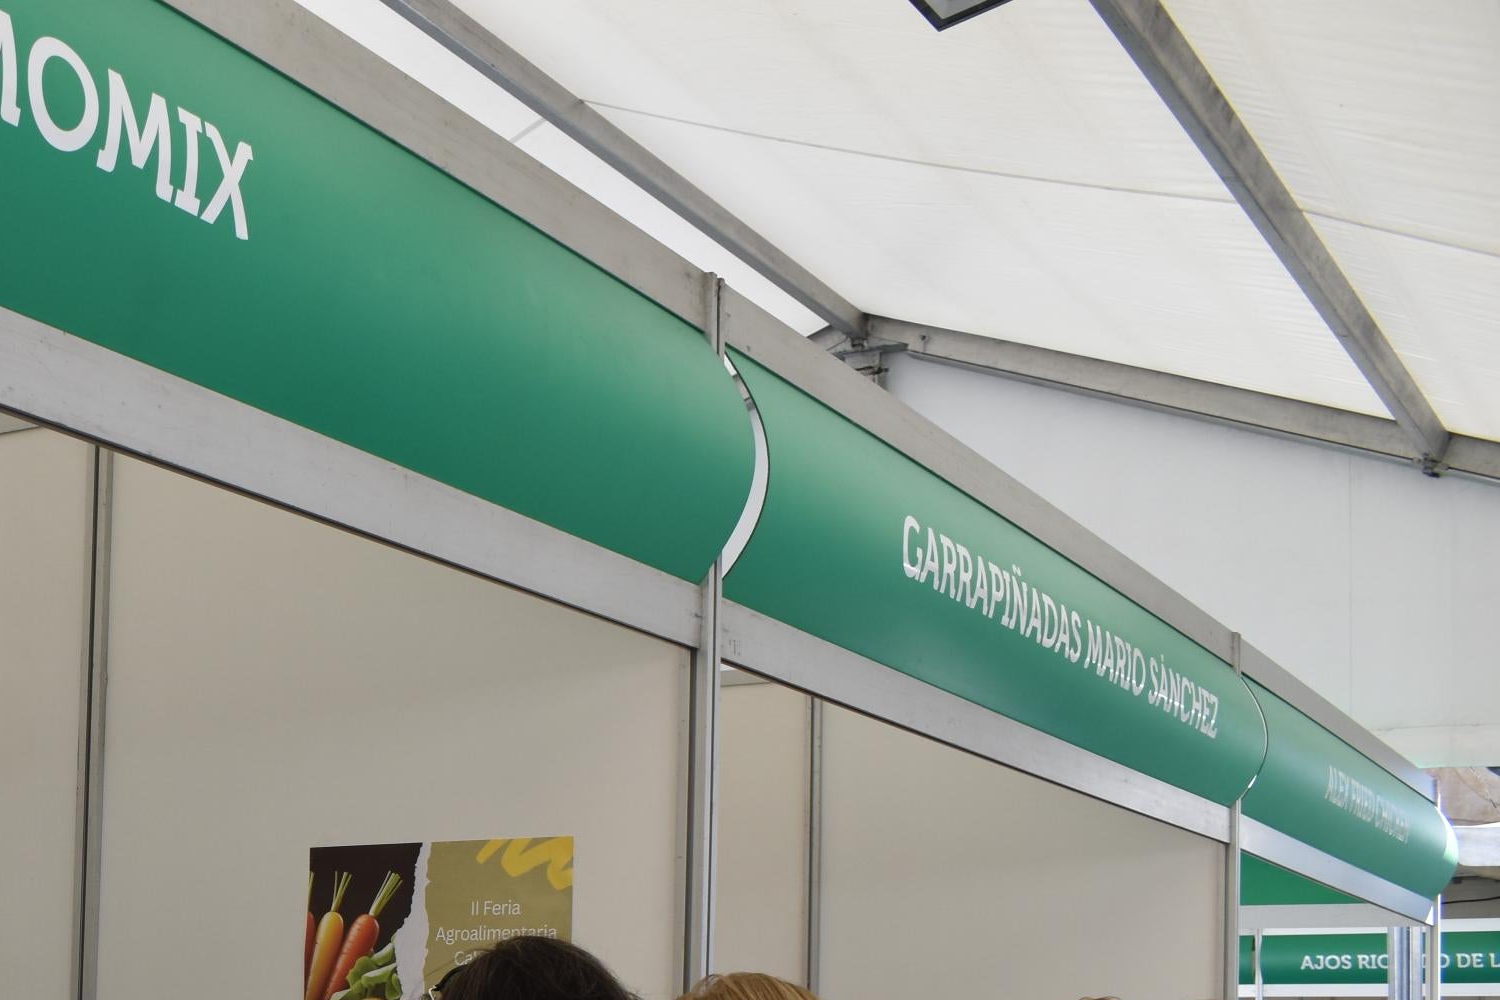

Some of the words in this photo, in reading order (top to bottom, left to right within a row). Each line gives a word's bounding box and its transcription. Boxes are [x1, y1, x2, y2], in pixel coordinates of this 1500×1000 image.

[903, 515, 1082, 663] GARRAPIÑADAS
[1084, 619, 1146, 696] MARIO
[1148, 654, 1219, 739] SÁNCHEZ
[483, 899, 522, 916] Feria
[1301, 955, 1352, 970] AJOS
[1456, 953, 1484, 968] DE
